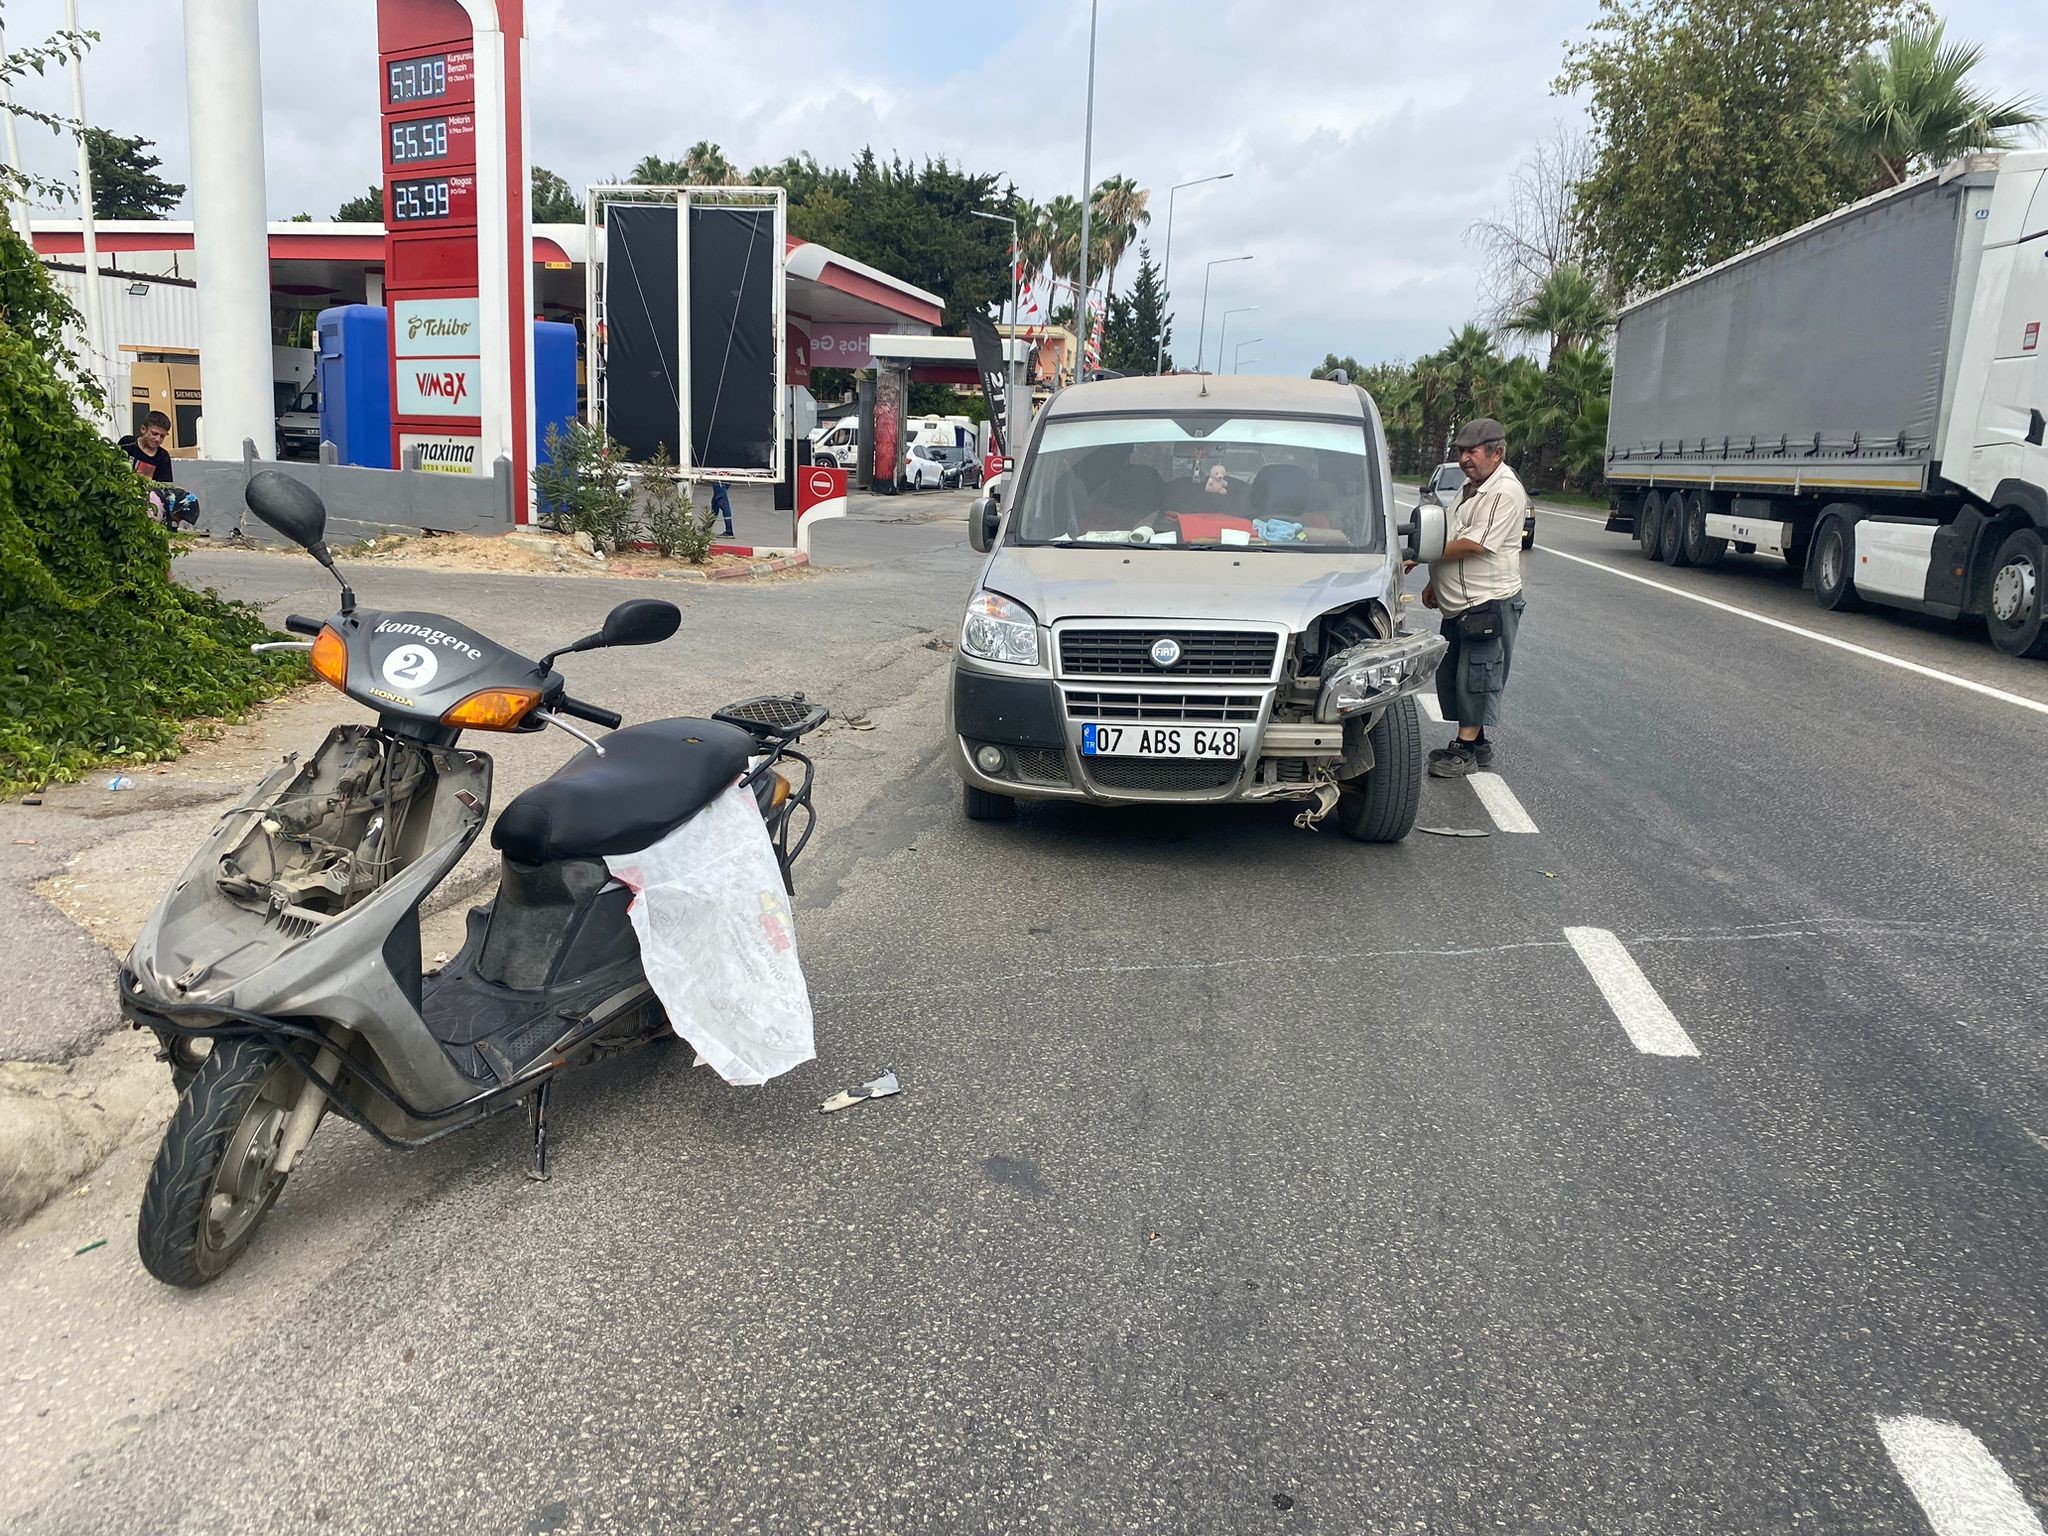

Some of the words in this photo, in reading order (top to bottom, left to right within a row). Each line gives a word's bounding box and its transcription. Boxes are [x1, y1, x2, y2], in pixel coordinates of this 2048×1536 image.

[447, 62, 467, 73] Benzin
[448, 115, 471, 125] Motorin
[393, 122, 448, 159] 55.58
[450, 177, 472, 188] Otogaz
[395, 183, 449, 219] 25.99
[423, 318, 471, 337] Tchibo
[417, 438, 475, 463] maxima
[374, 618, 482, 661] komagene
[1155, 647, 1175, 657] FIAT
[393, 652, 425, 680] 2
[369, 687, 416, 708] HONDA
[1097, 728, 1123, 752] 07
[1138, 729, 1181, 754] ABS
[1194, 730, 1236, 756] 648
